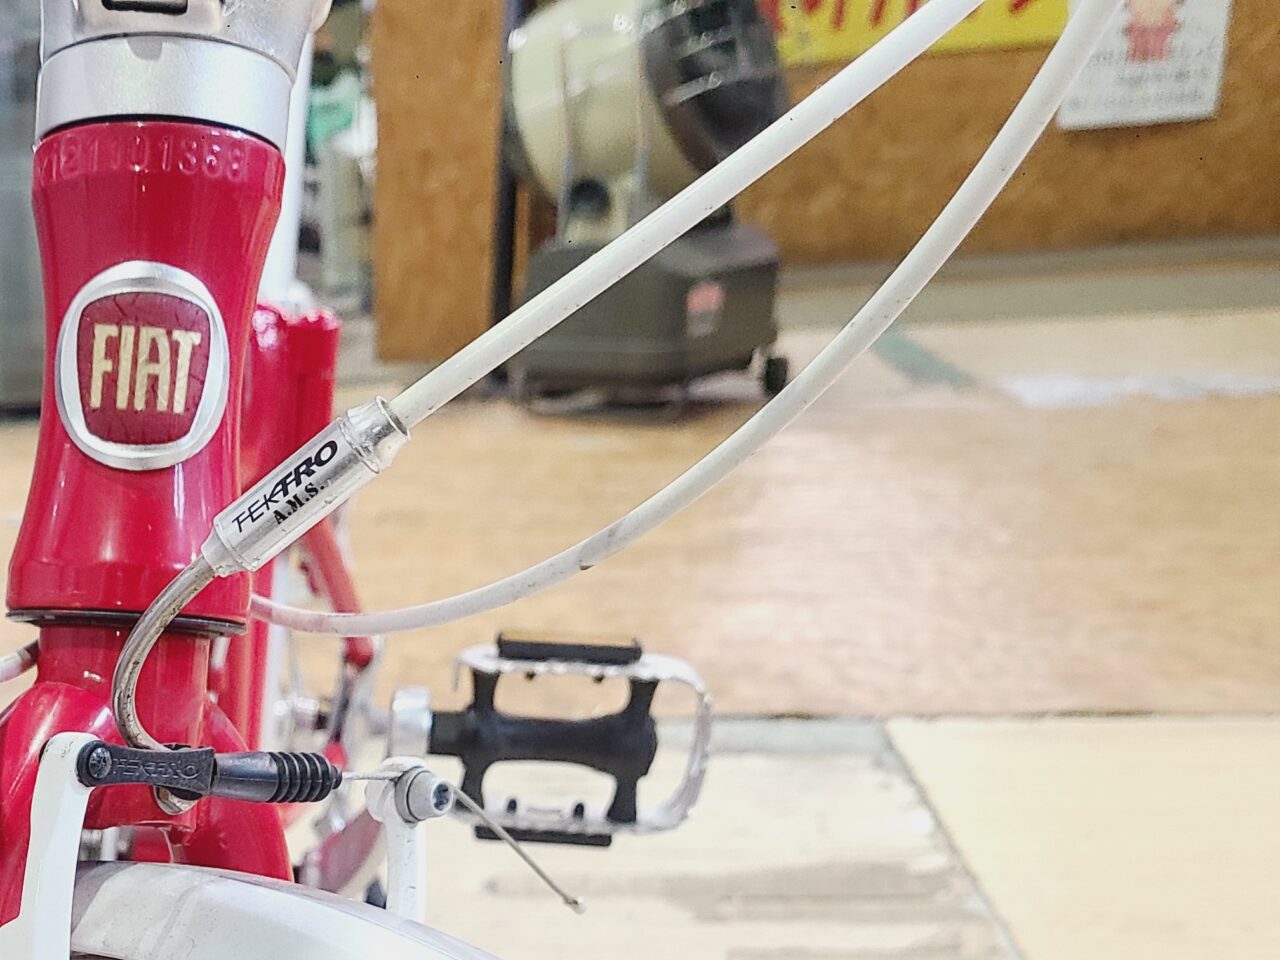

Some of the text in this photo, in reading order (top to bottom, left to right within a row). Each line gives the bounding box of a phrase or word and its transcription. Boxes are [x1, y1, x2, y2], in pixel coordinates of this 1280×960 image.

[89, 323, 202, 415] FIAT
[231, 440, 338, 533] TEKTRO
[272, 482, 325, 525] A.M.S.
